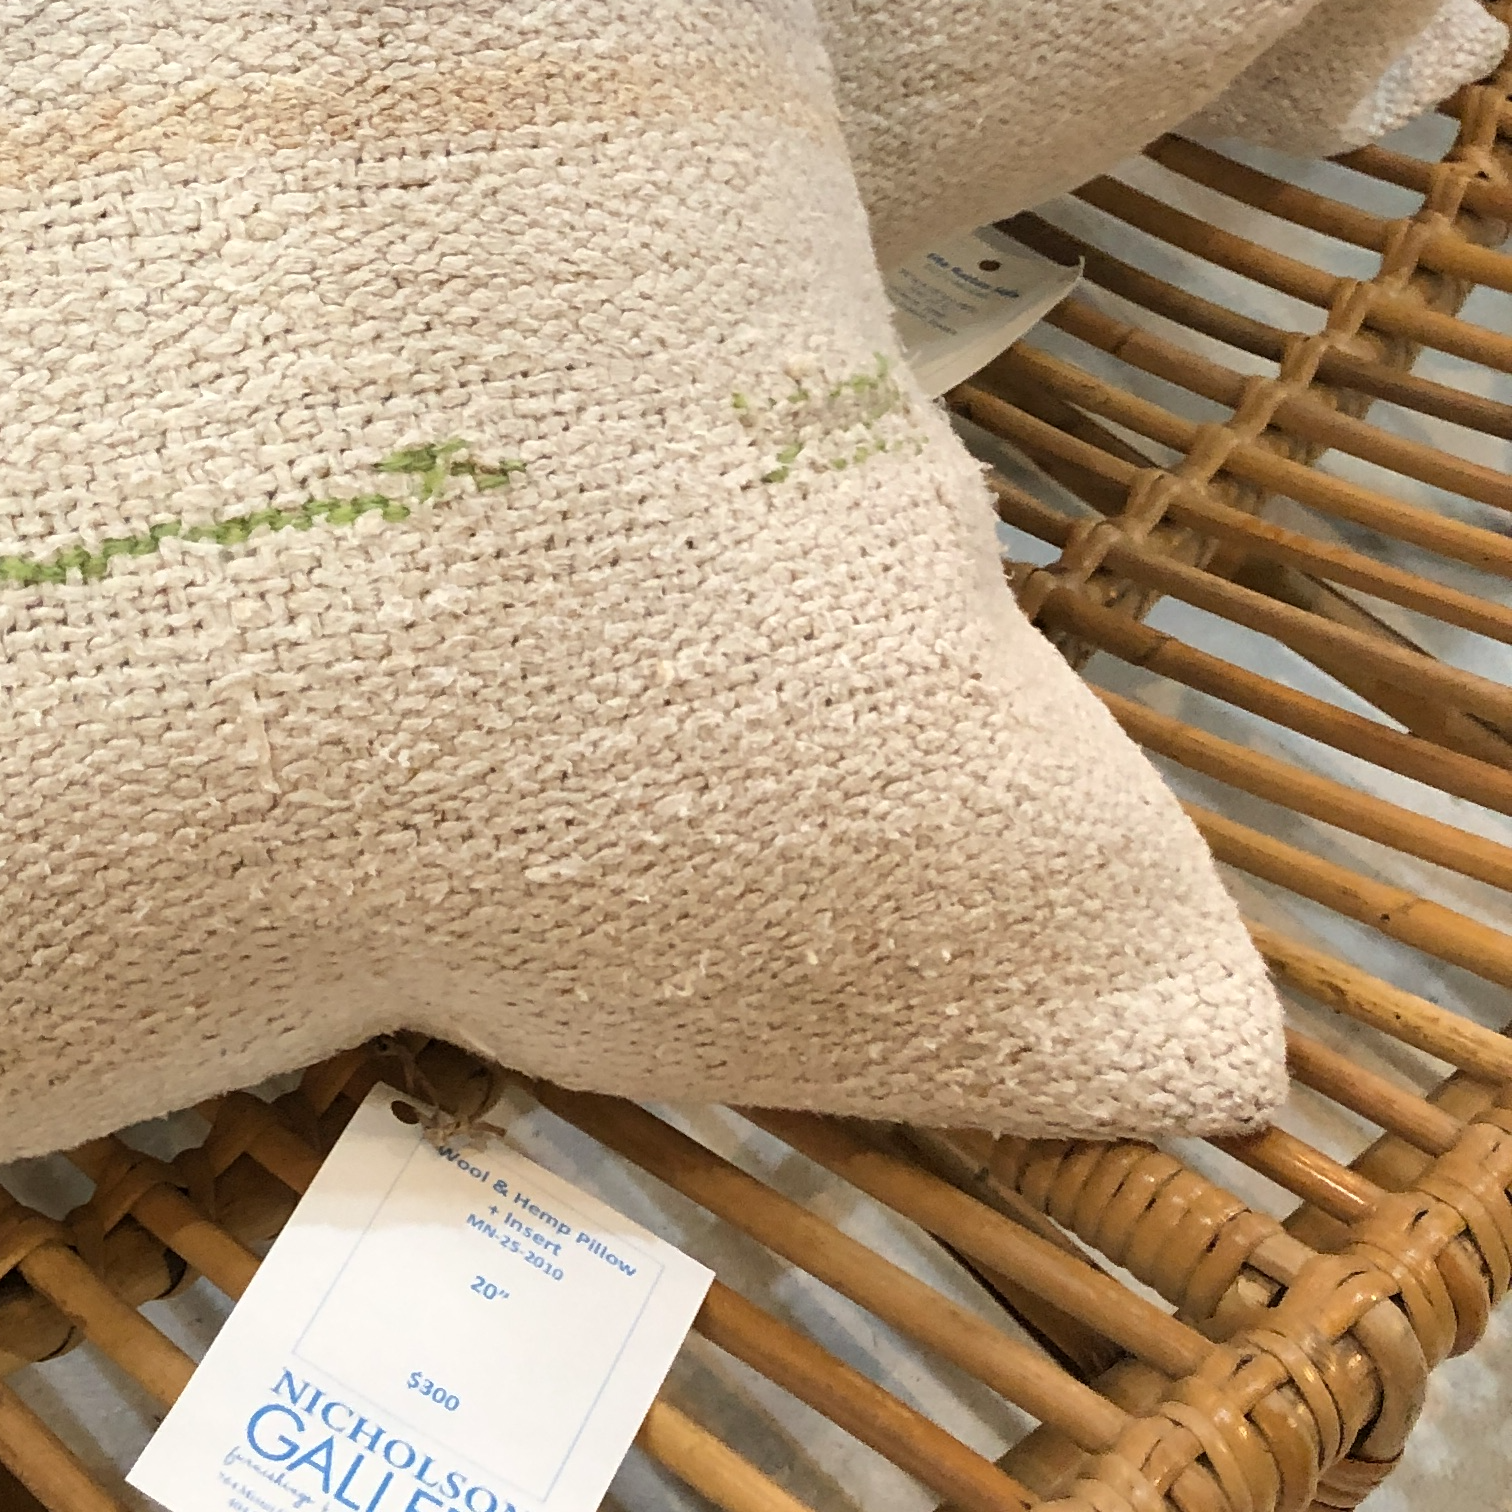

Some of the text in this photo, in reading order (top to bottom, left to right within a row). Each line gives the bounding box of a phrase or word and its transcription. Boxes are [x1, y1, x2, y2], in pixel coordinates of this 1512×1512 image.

[438, 1145, 637, 1277] Wool & Hemp Pillow
[488, 1205, 562, 1256] + Insert
[466, 1213, 564, 1281] MN-25-2010
[406, 1371, 460, 1412] $300
